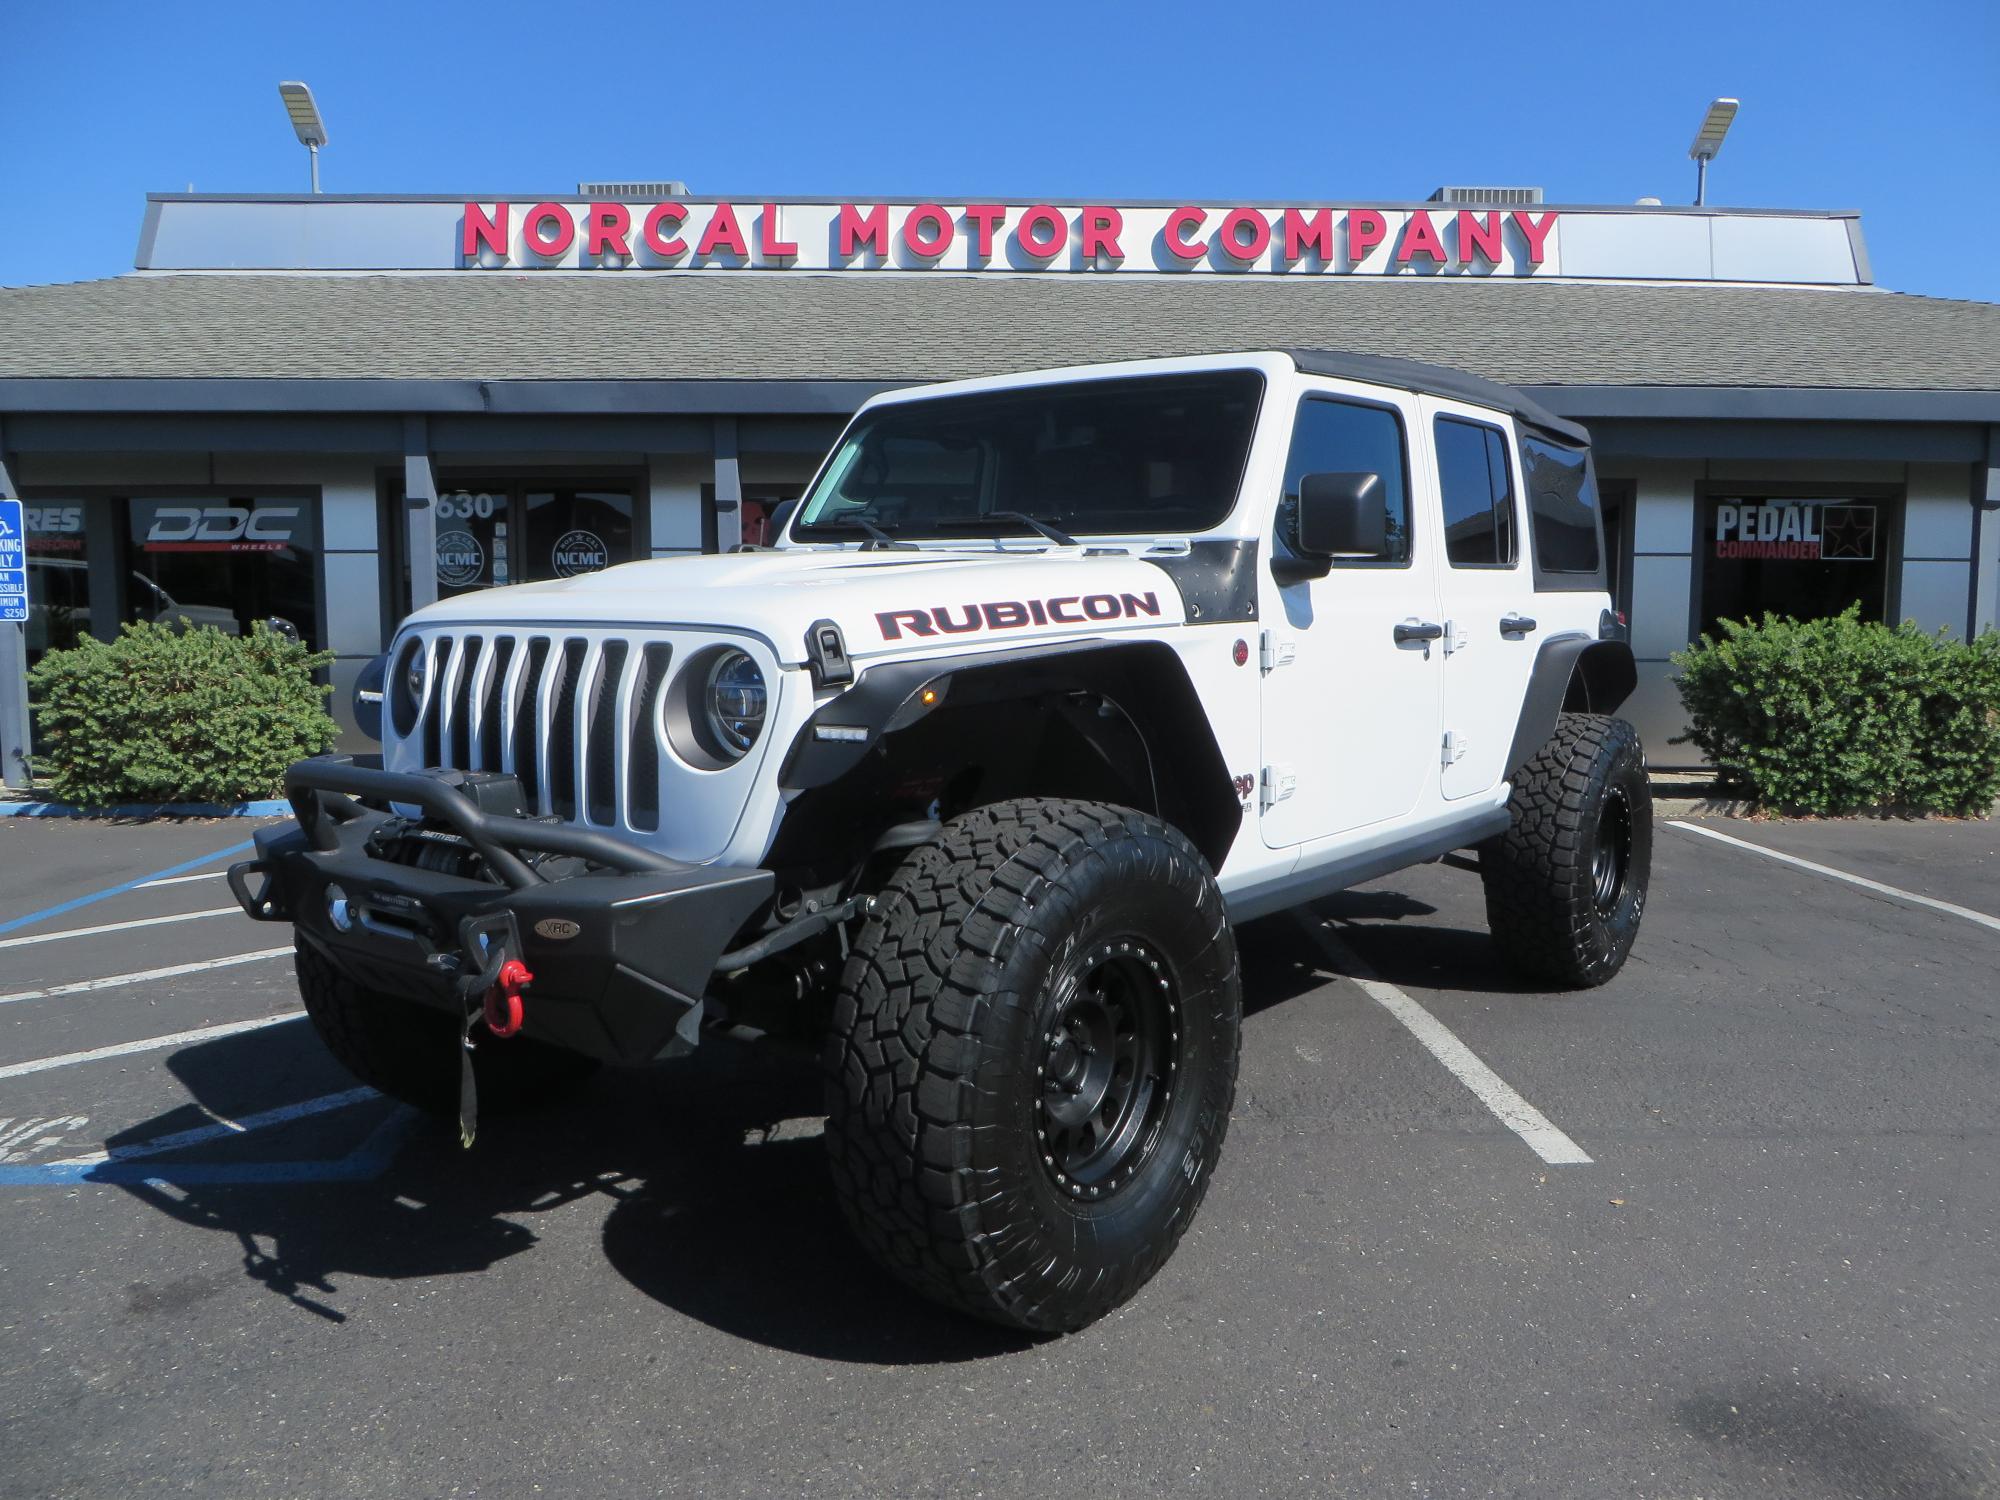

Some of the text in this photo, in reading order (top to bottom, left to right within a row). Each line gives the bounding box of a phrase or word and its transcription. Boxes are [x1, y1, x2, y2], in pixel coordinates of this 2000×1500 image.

[463, 202, 1560, 264] NORCAL MOTOR COMPANY
[436, 493, 494, 518] 630
[147, 508, 299, 540] DDC
[1716, 505, 1820, 542] PEDAL
[556, 551, 604, 565] NCMC
[1716, 541, 1819, 559] COMMANDER
[874, 591, 1161, 640] RUBICON
